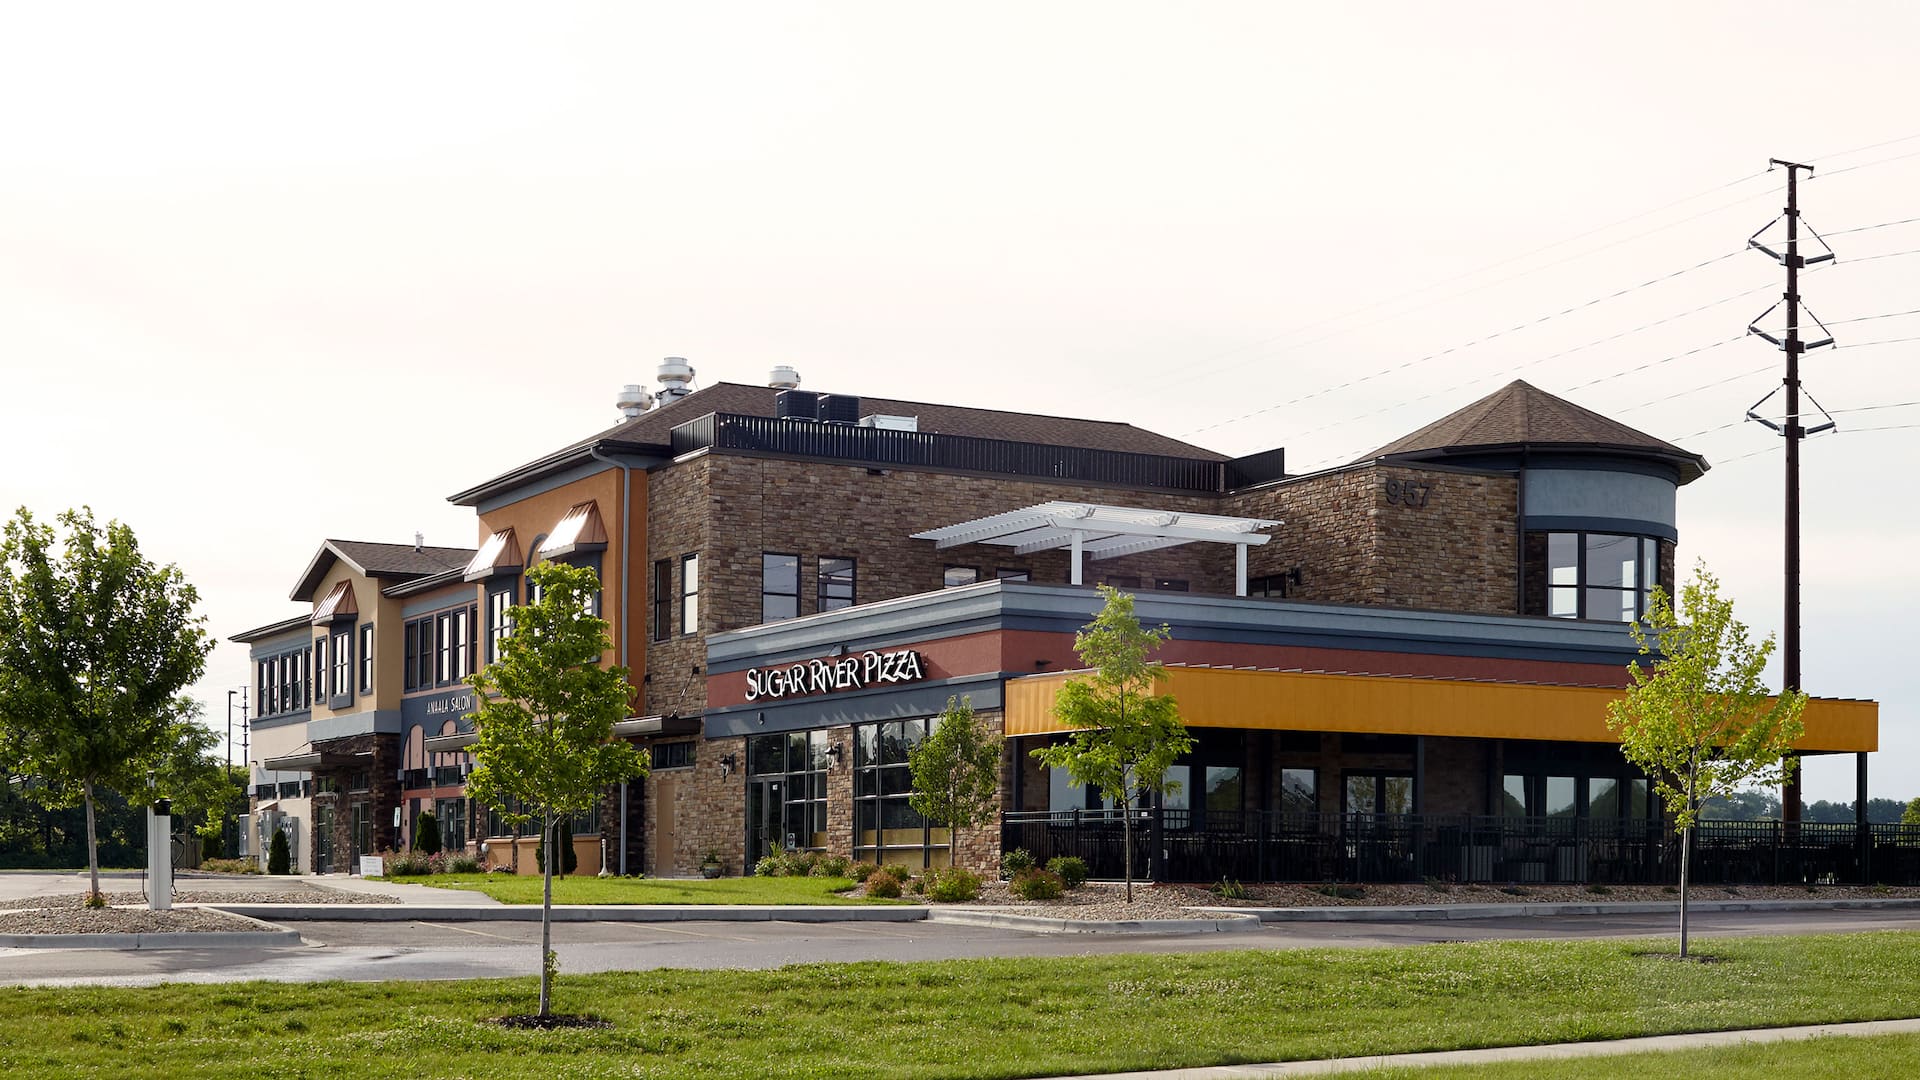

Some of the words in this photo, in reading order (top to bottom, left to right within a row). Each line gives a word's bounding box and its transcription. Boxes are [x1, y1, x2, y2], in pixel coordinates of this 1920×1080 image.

[1386, 479, 1432, 507] 957
[744, 664, 807, 701] SUGAR
[809, 657, 862, 693] RIVER
[862, 649, 923, 683] PIZZA
[451, 695, 472, 712] SALON
